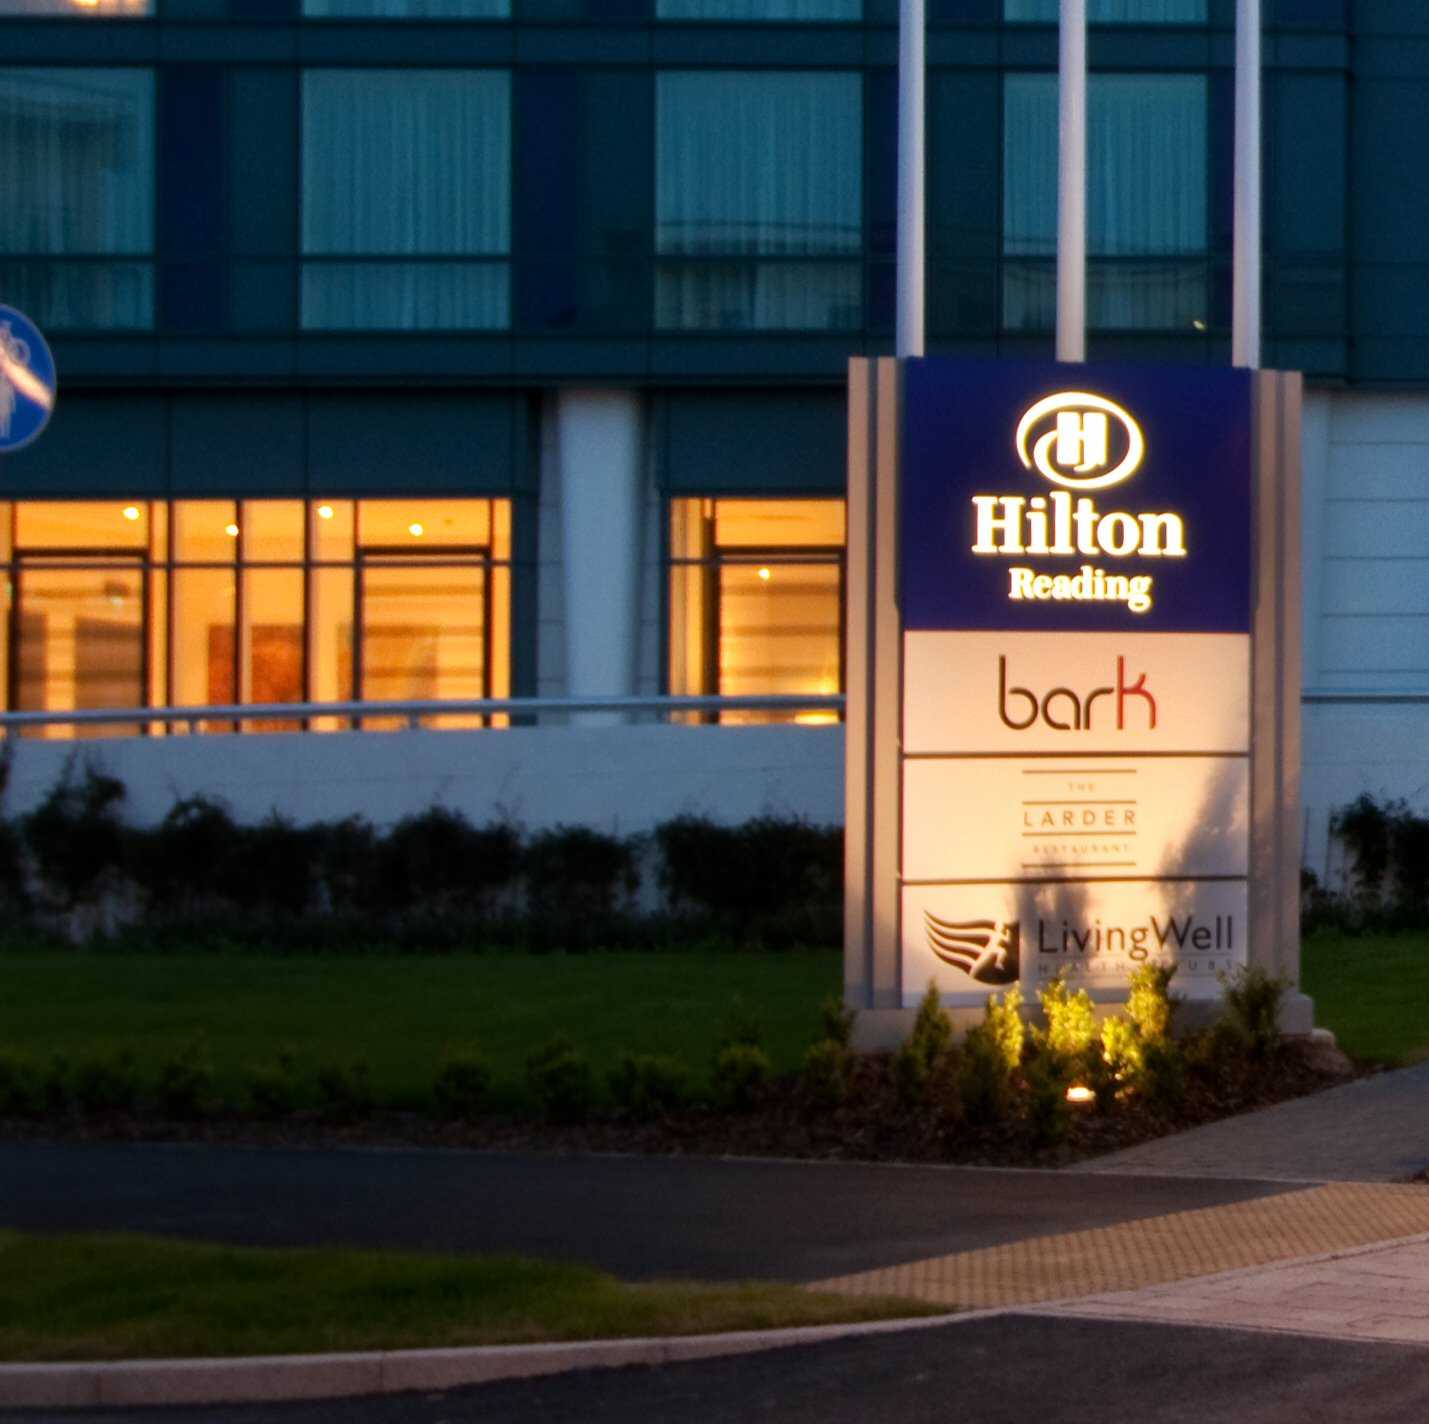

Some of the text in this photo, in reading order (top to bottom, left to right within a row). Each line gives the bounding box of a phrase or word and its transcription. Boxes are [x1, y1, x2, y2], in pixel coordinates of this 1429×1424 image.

[971, 491, 1187, 557] Hilton
[1008, 565, 1153, 613] Reading
[999, 654, 1157, 731] bark
[1068, 782, 1095, 793] THE
[1023, 809, 1136, 827] LARDER
[1033, 843, 1130, 855] RESTAURANT
[1038, 914, 1233, 961] LivingWell
